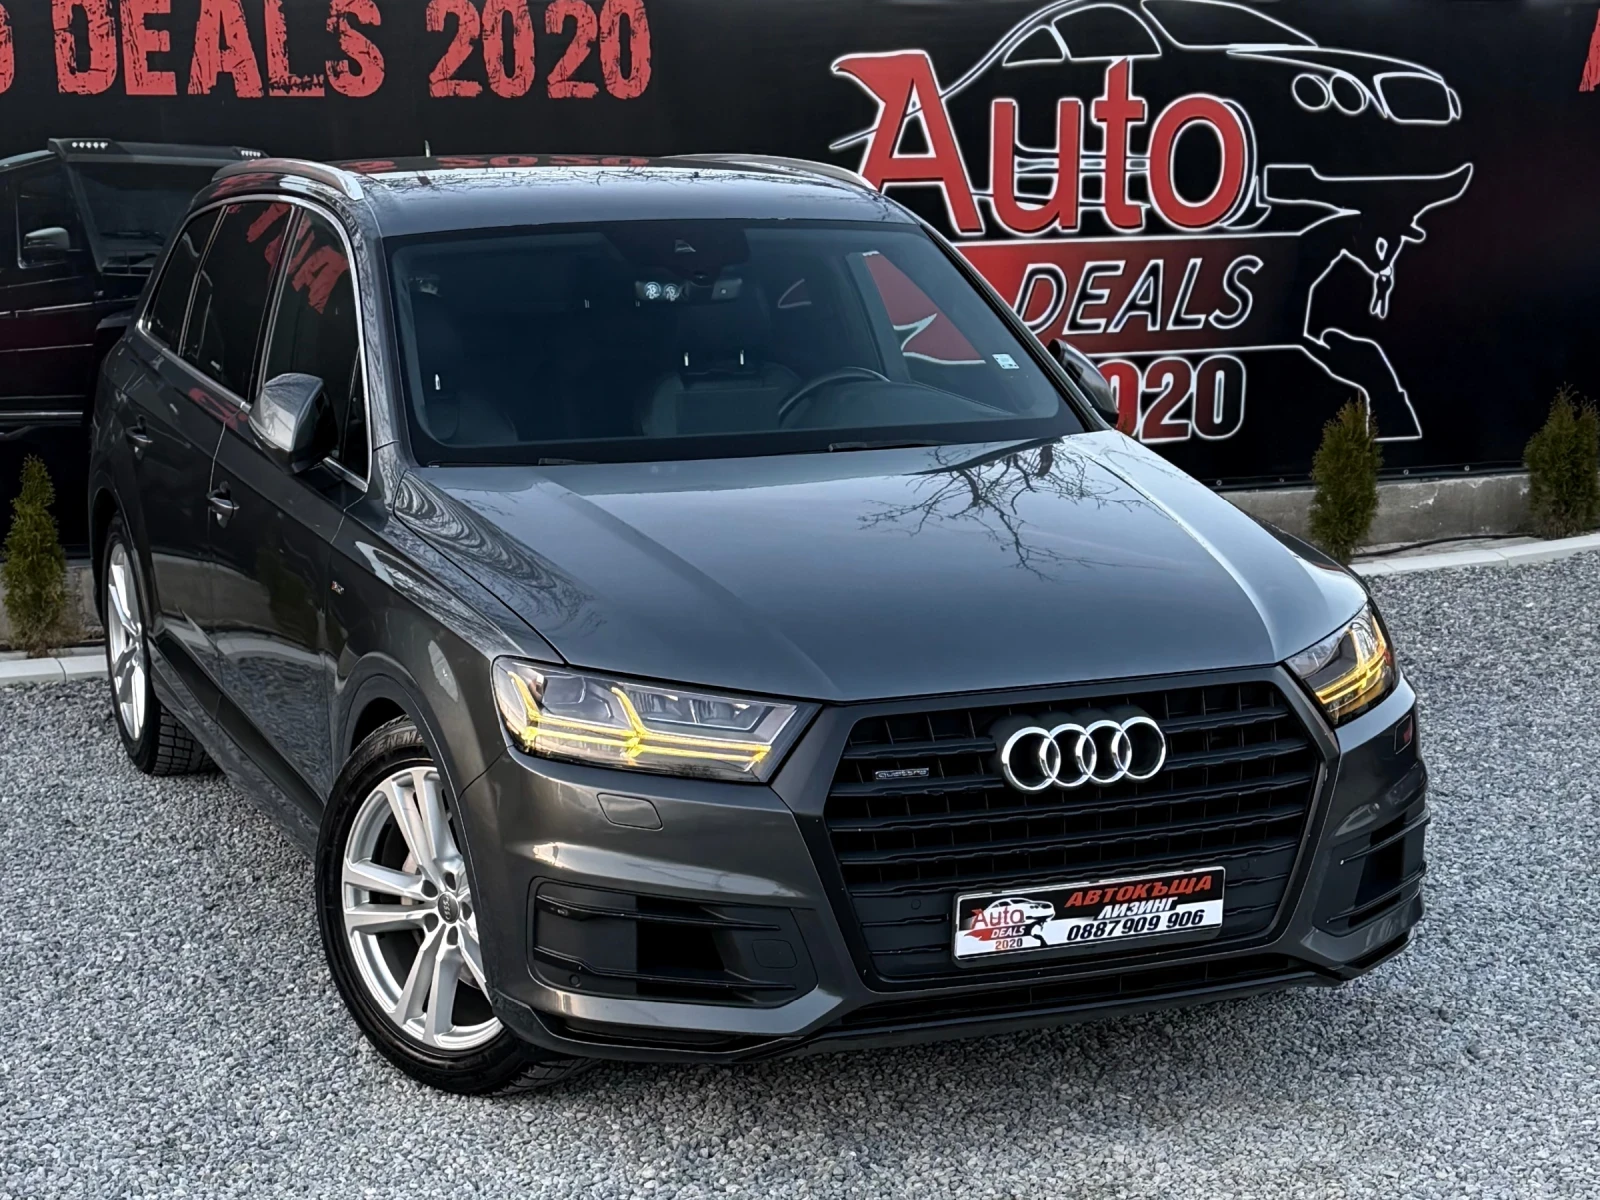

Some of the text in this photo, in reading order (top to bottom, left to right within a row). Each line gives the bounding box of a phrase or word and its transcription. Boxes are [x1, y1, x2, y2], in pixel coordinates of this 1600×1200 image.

[52, 0, 385, 98] DEALS
[426, 0, 651, 99] 2020
[832, 50, 1247, 236] Auto
[1013, 256, 1263, 335] DEALS
[1098, 354, 1247, 444] 020
[1064, 875, 1212, 908] АВТОКЪЩА
[971, 906, 1026, 930] Auto
[1097, 896, 1178, 920] ЛИЗИНГ
[1166, 909, 1205, 929] 906
[991, 926, 1026, 939] DEALS
[995, 938, 1023, 950] 2020
